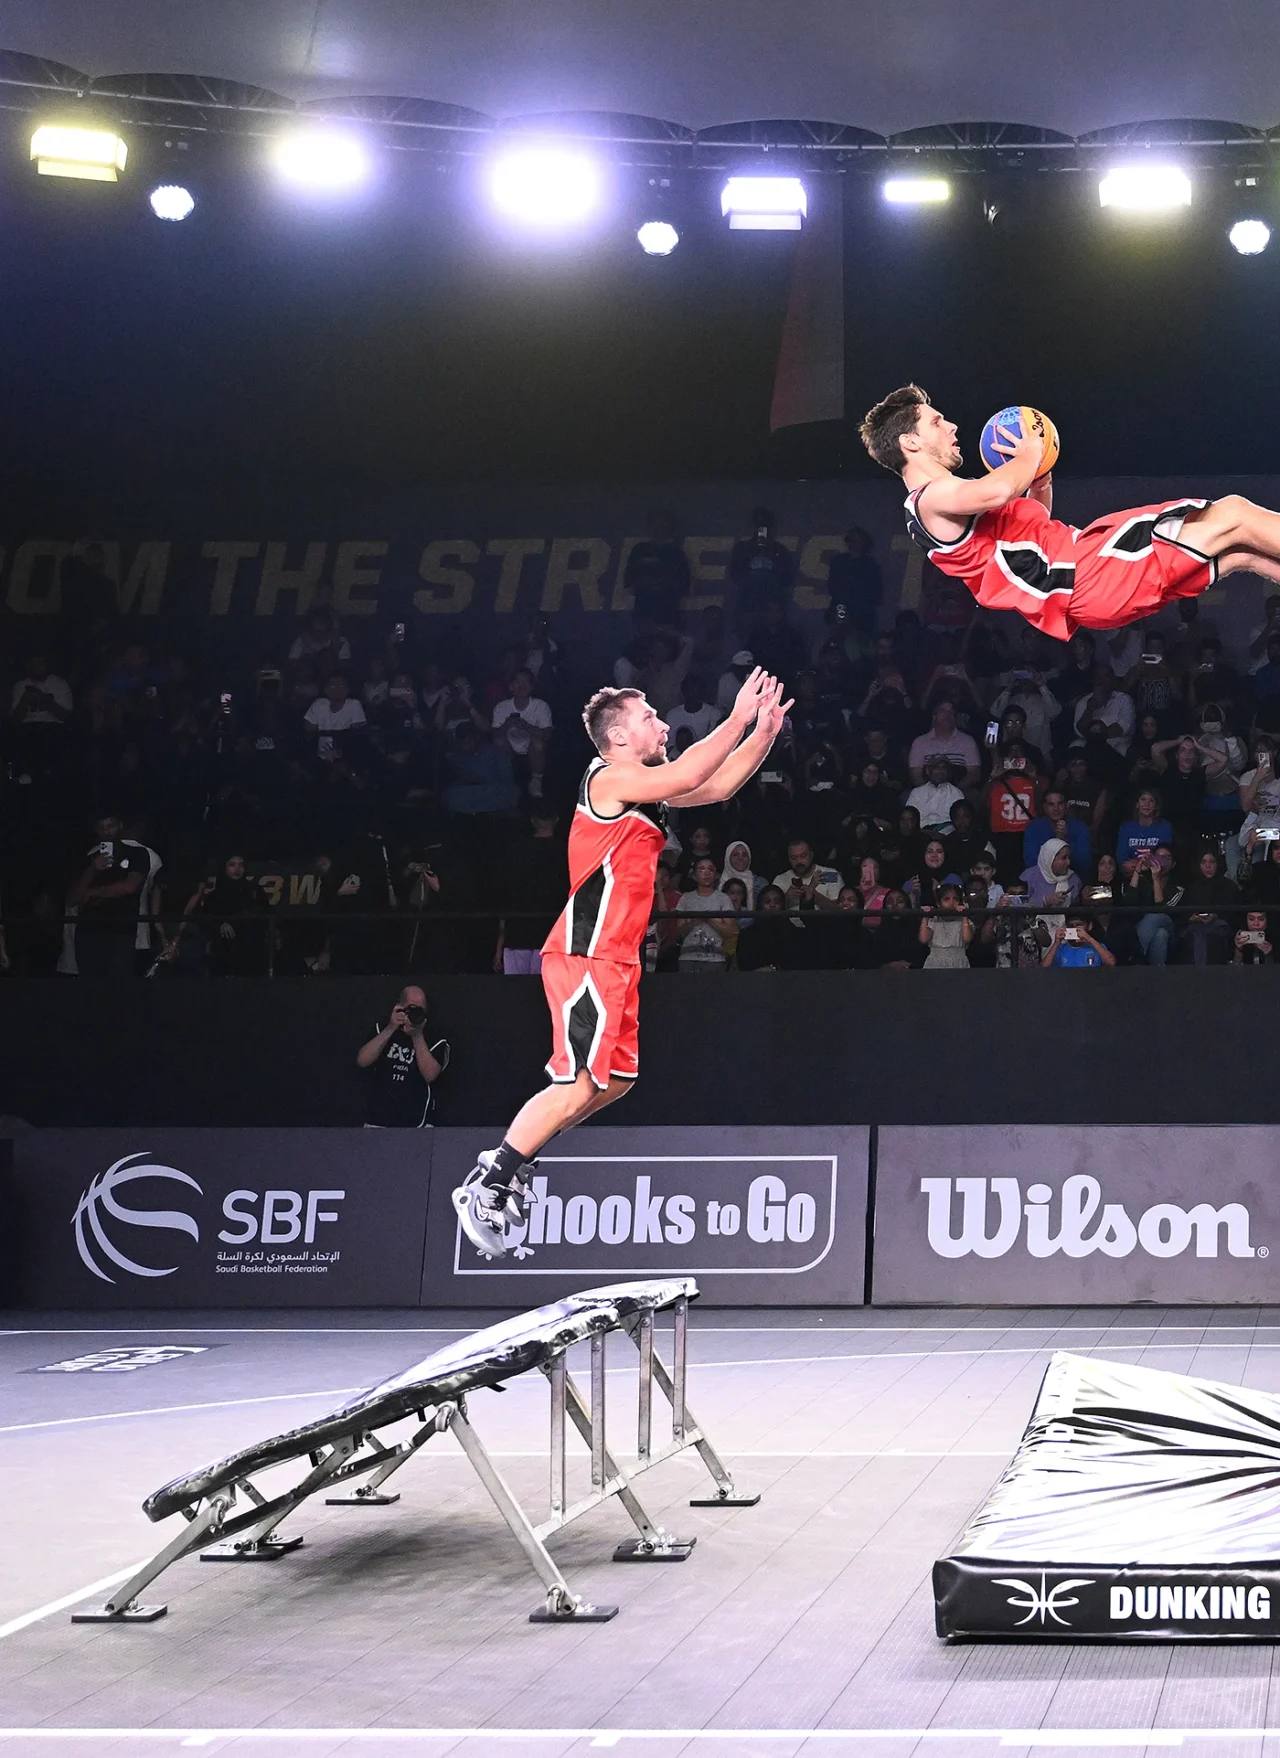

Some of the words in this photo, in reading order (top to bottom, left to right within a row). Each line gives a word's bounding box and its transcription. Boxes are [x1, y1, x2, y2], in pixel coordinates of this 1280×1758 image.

[201, 540, 389, 616] THE
[217, 1189, 346, 1244] SBF
[706, 1200, 741, 1236] to
[747, 1175, 817, 1244] Go
[920, 1174, 1256, 1259] Wilson
[215, 1265, 238, 1273] Saudi
[240, 1264, 282, 1273] Basketball
[284, 1264, 328, 1273] Federation
[1109, 1585, 1271, 1620] DUNKING
